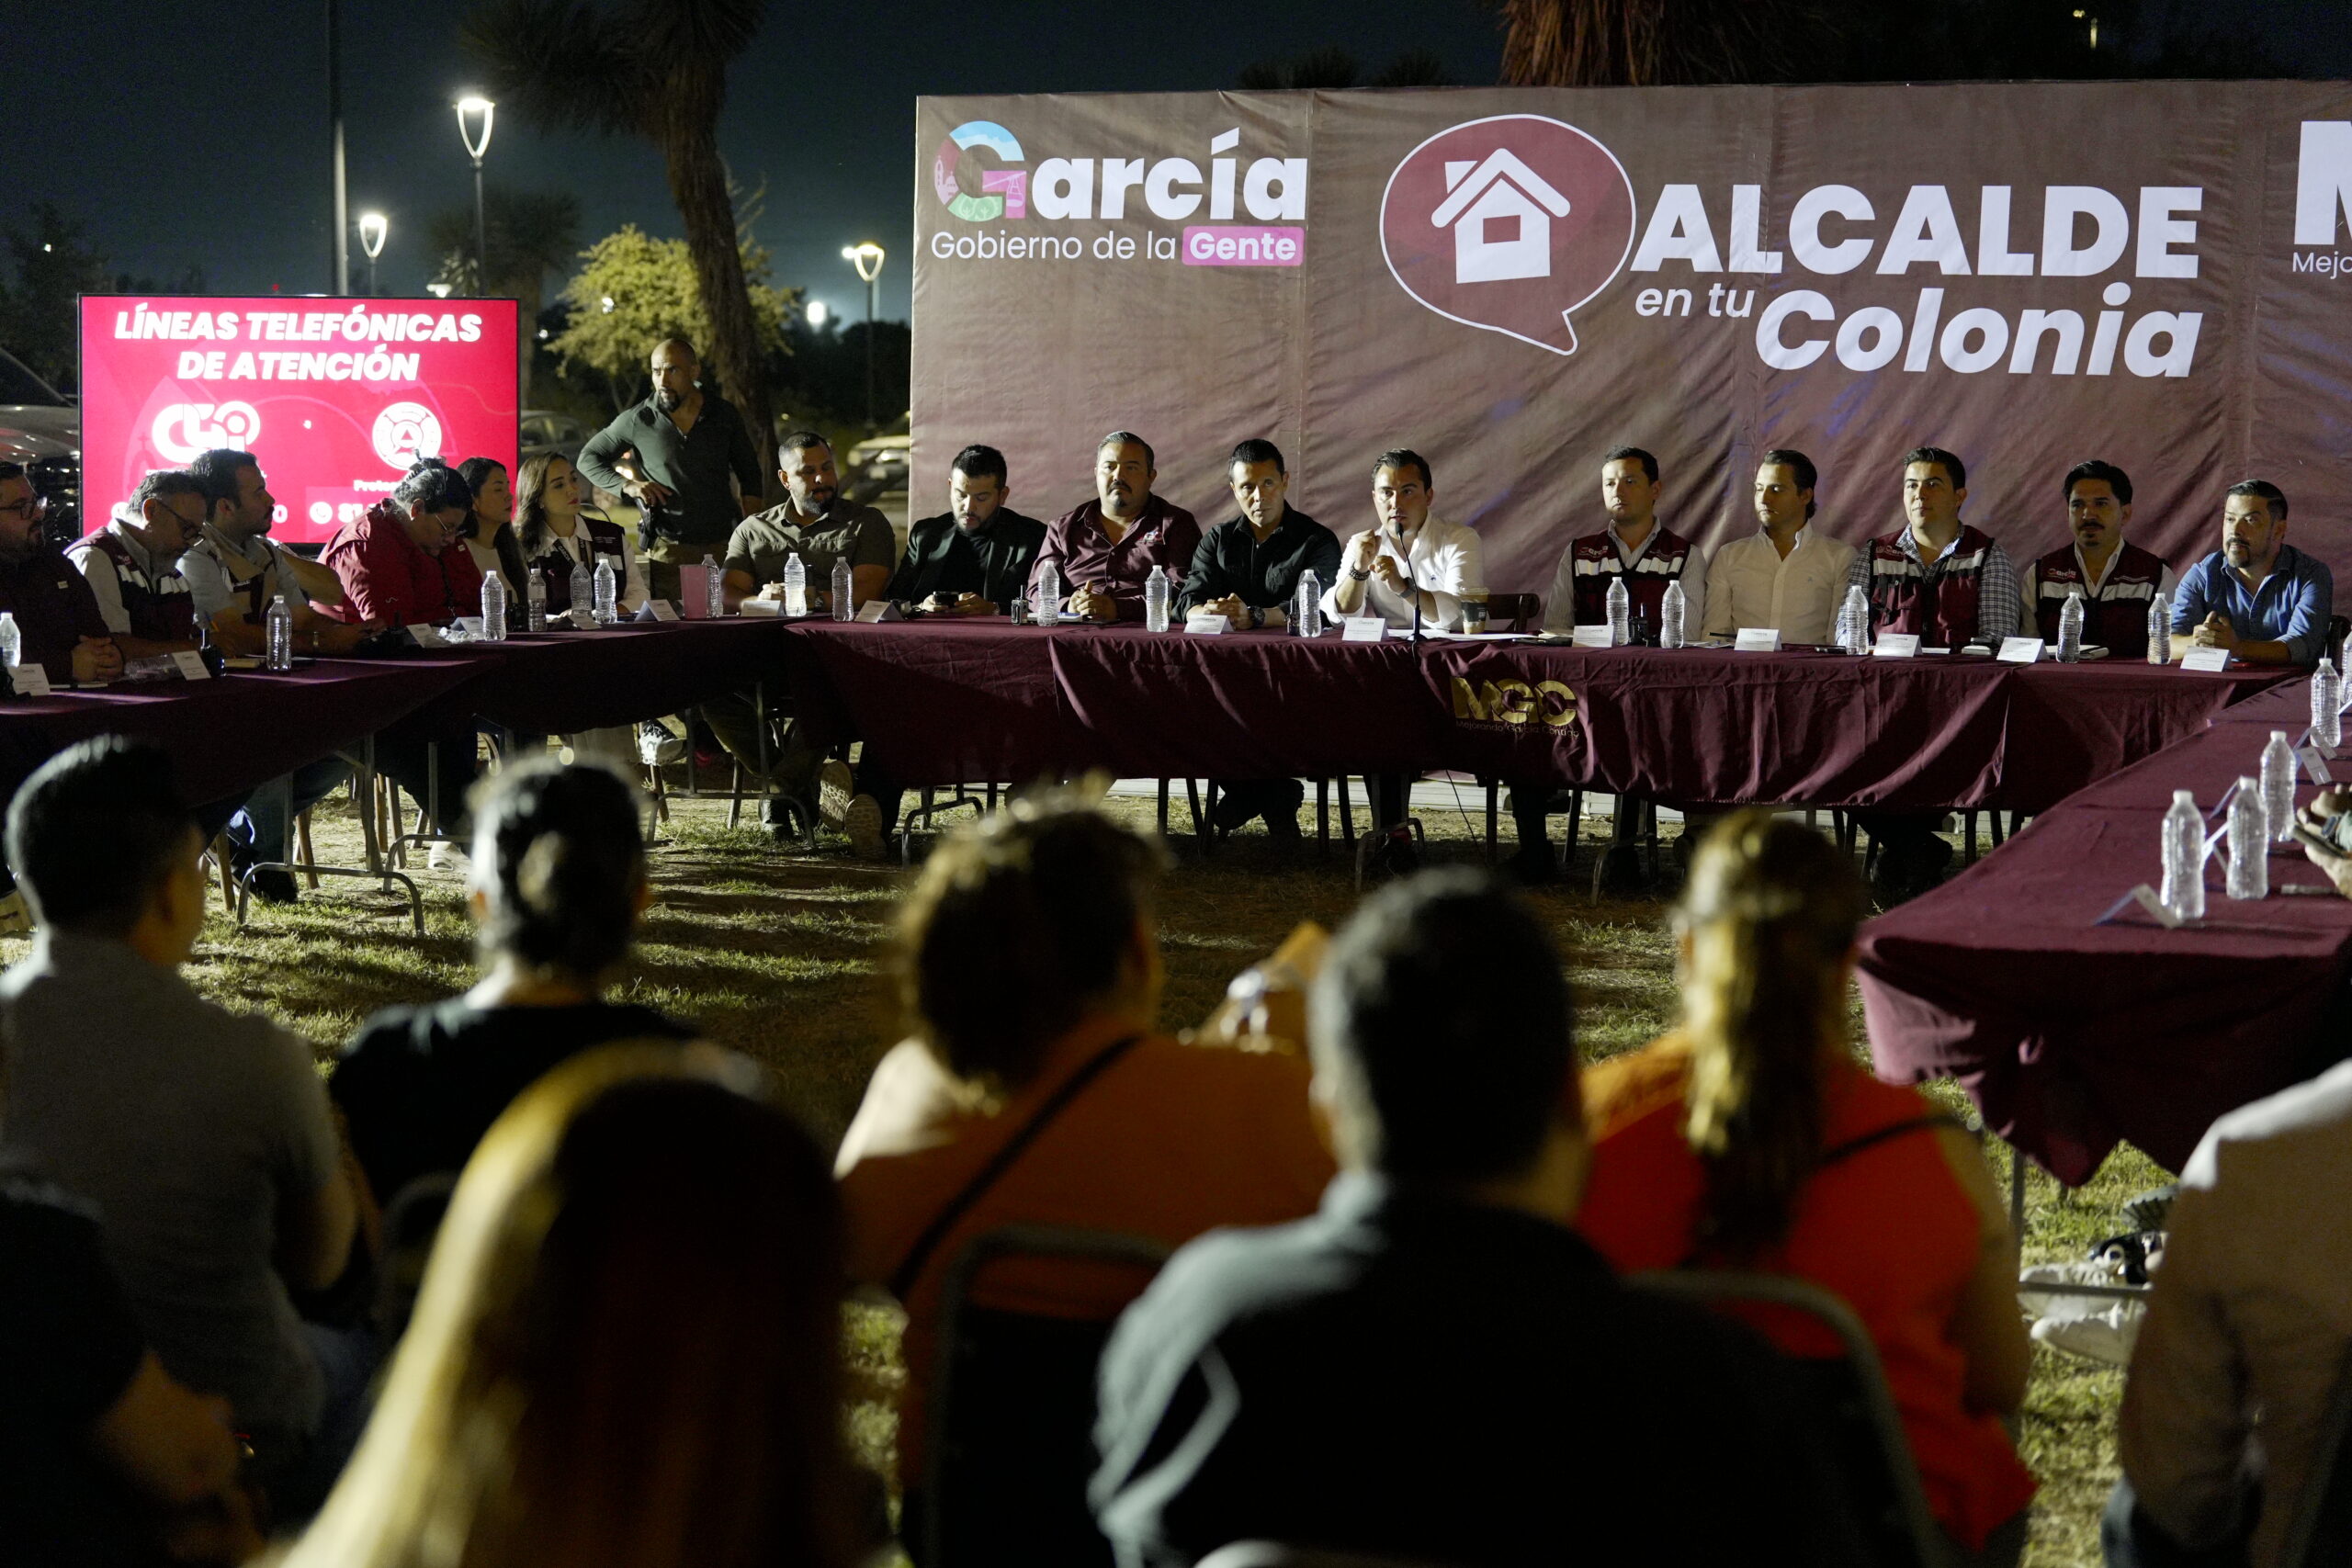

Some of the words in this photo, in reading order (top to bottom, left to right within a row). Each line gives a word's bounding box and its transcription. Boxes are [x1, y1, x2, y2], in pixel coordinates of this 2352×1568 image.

[933, 120, 1308, 222] García
[931, 230, 1082, 260] Gobierno
[1092, 230, 1136, 260] de
[1147, 230, 1176, 260] la
[1189, 231, 1297, 261] Gente
[1630, 184, 2203, 278] ALCALDE
[114, 302, 239, 340] LÍNEAS
[245, 304, 482, 343] TELEFÓNICAS
[1634, 288, 1692, 318] en
[1708, 282, 1755, 318] tu
[1755, 281, 2203, 378] Colonia
[177, 351, 225, 379] DE
[228, 344, 420, 381] ATENCIÓN
[1452, 677, 1577, 727] MGC
